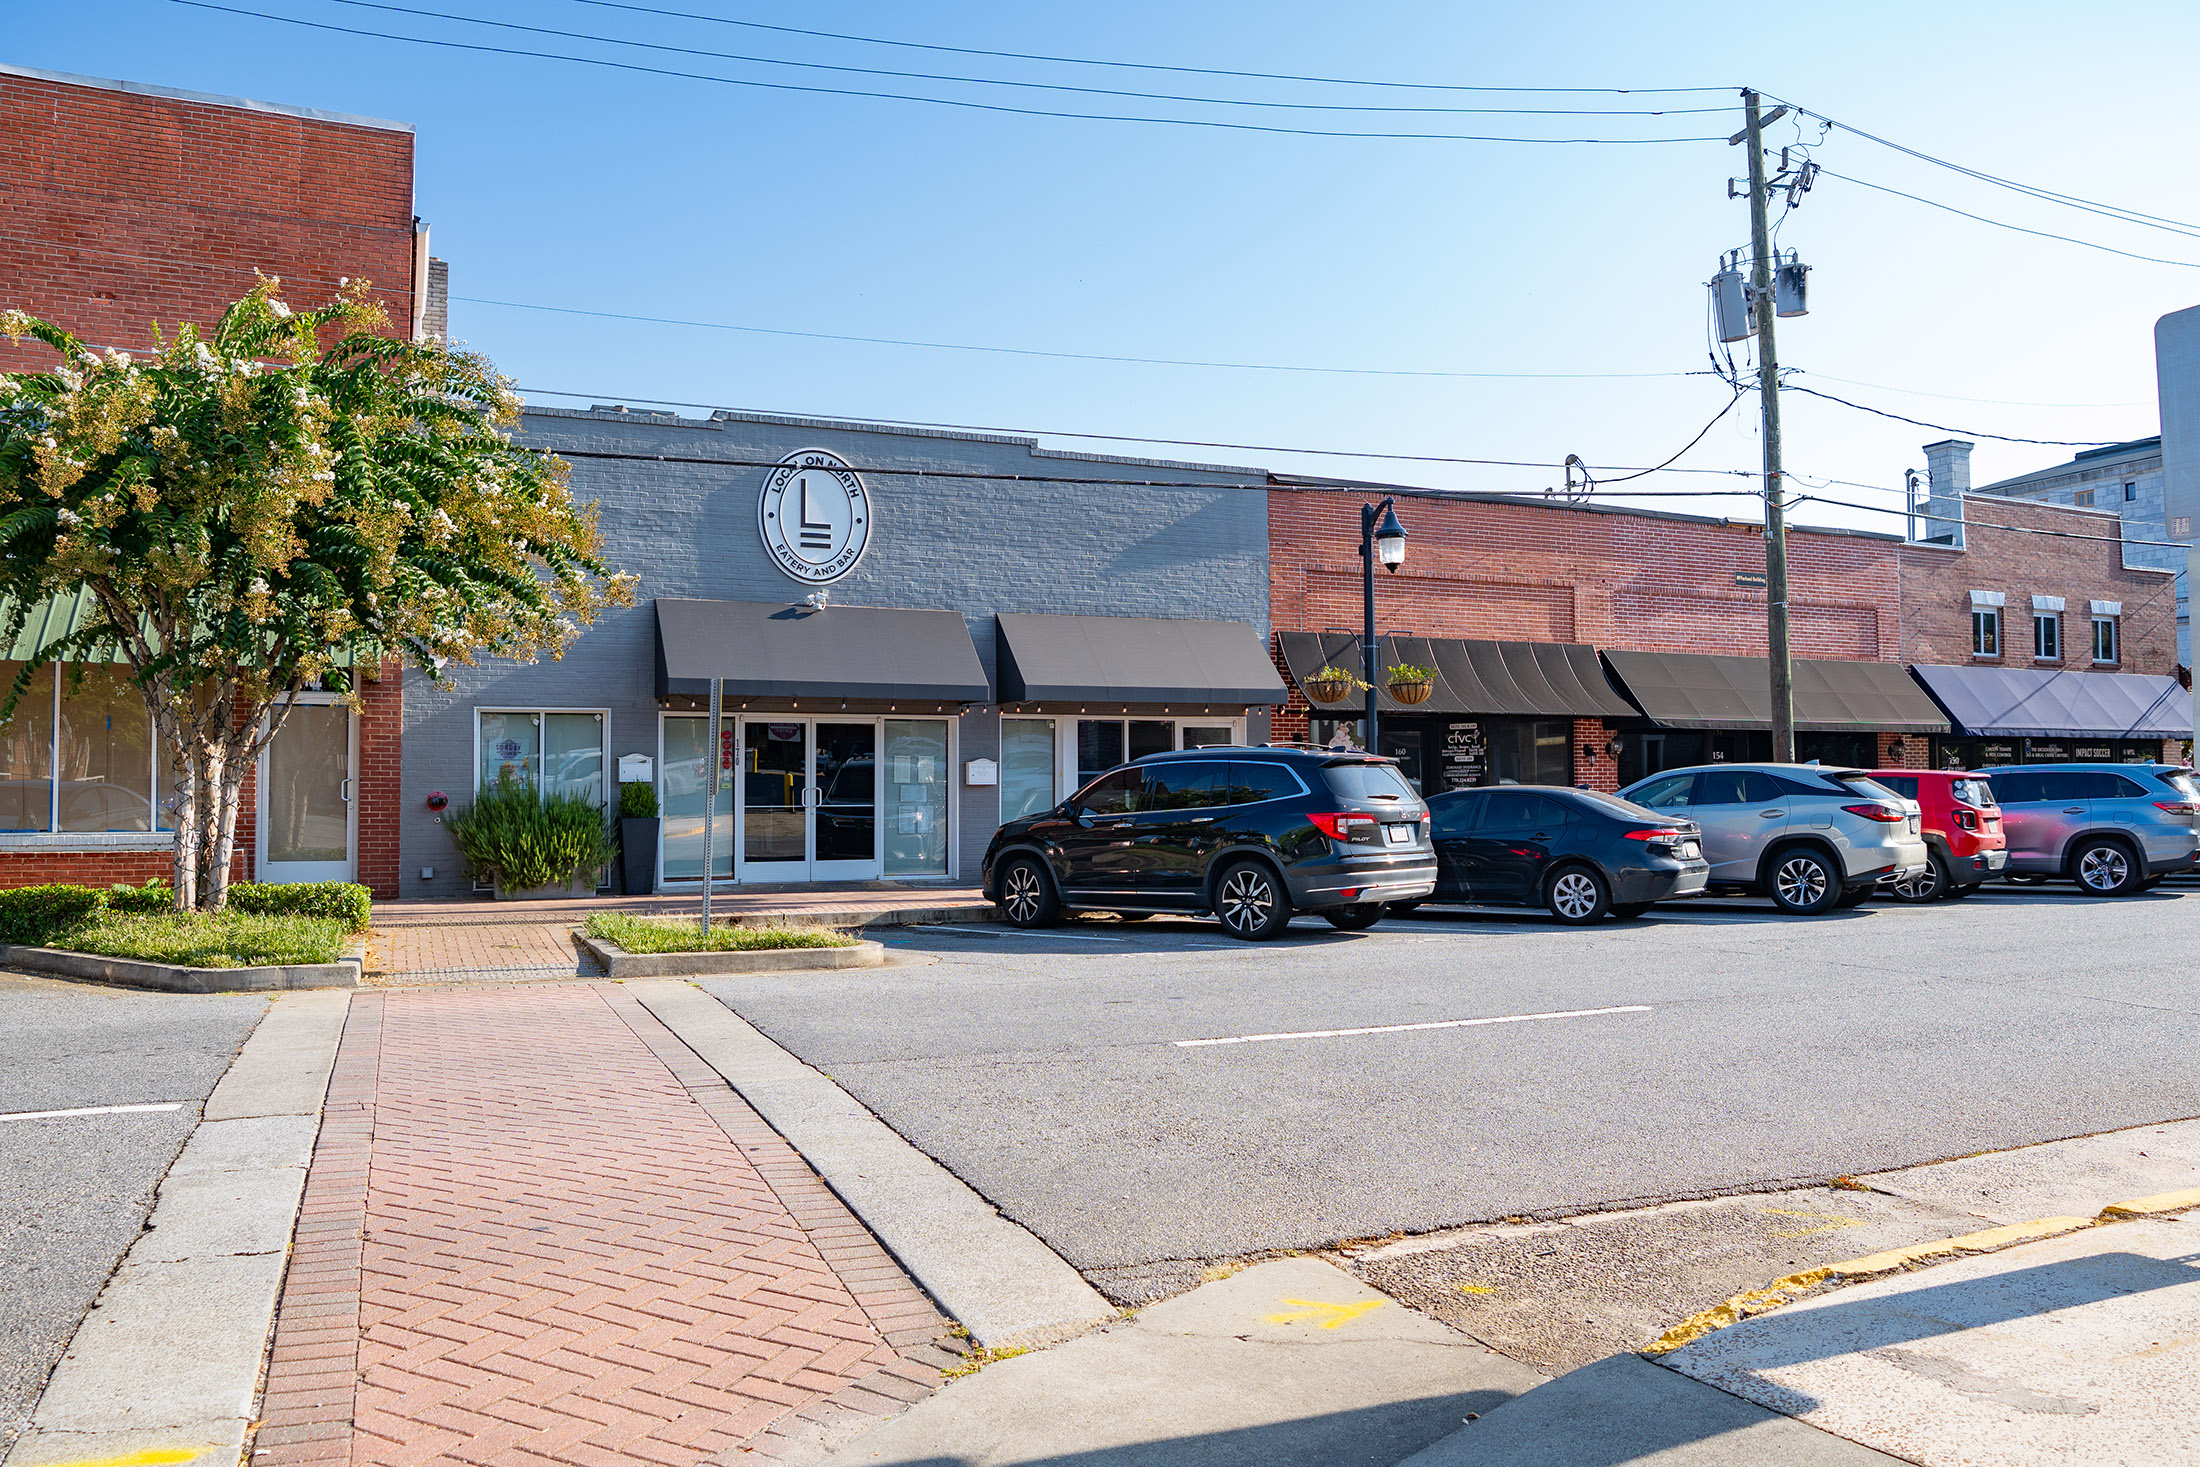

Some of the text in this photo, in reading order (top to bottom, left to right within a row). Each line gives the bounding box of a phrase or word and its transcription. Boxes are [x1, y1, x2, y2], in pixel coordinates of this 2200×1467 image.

[772, 460, 799, 494] LOCA
[805, 456, 825, 467] ON
[800, 478, 832, 530] L
[776, 543, 855, 577] EATERY AND BAR
[1448, 731, 1472, 744] cfvc
[1713, 752, 1724, 760] 154
[2075, 748, 2111, 758] IMPACT SOCCER
